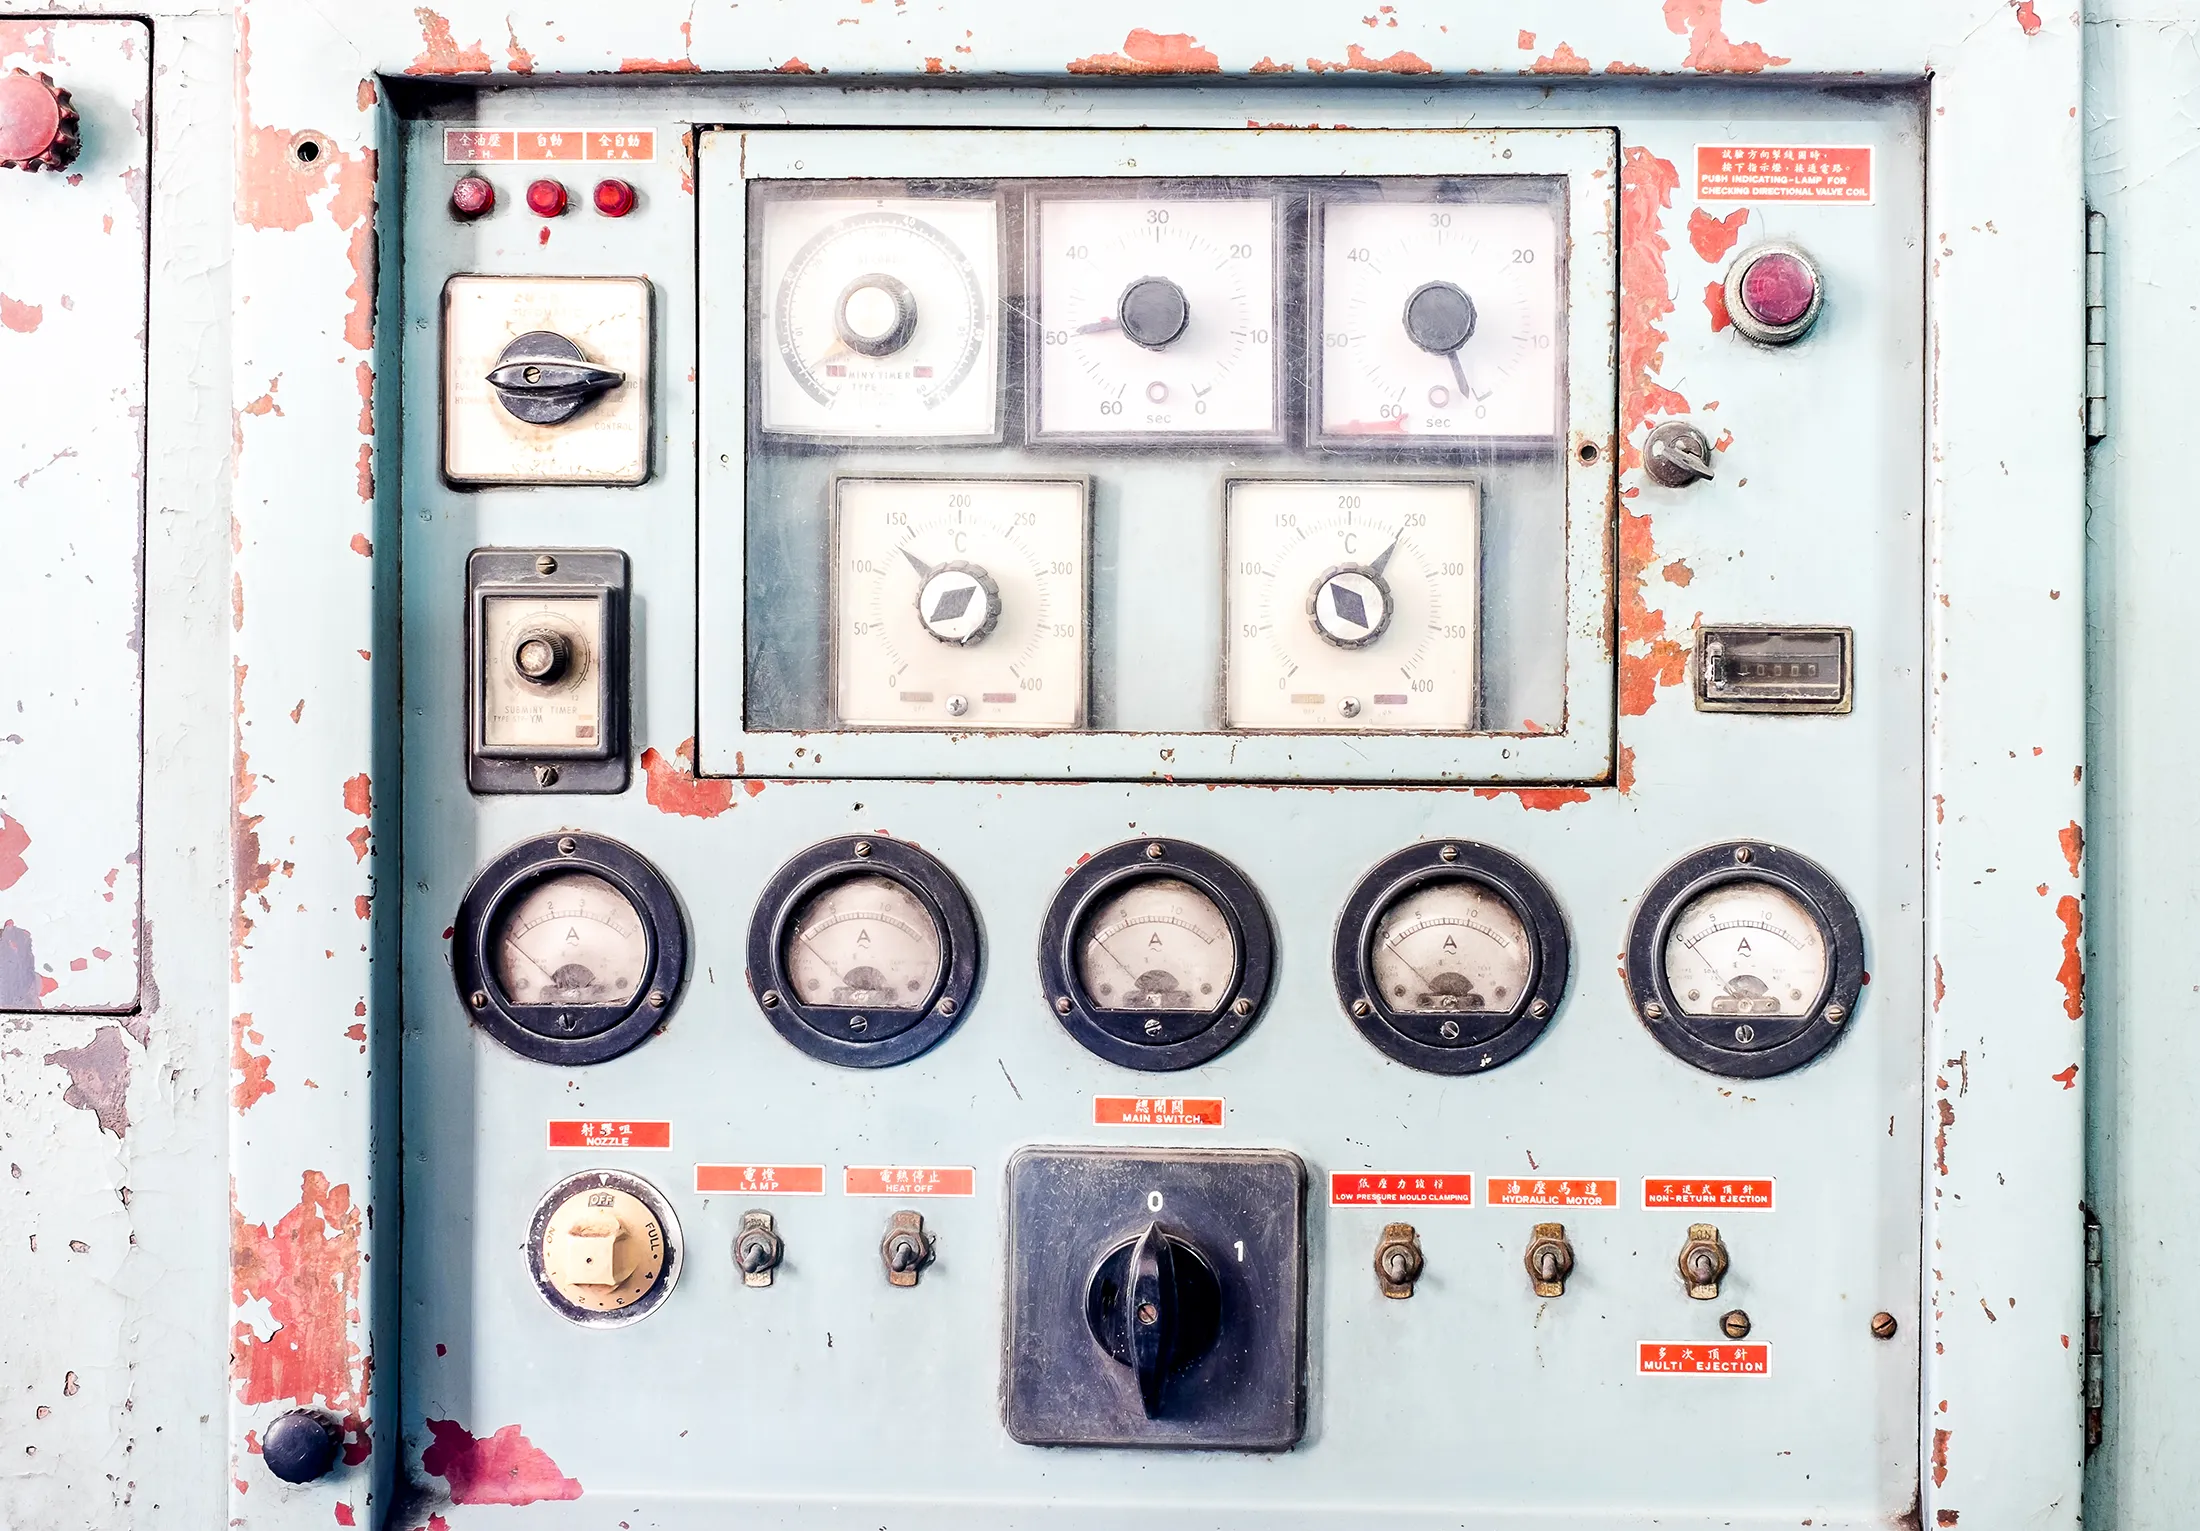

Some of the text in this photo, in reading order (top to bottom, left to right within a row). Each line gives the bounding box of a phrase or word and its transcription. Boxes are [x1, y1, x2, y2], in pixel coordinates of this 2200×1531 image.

[536, 133, 563, 147] 自動
[598, 133, 641, 147] 全自動
[545, 149, 556, 158] A.
[1701, 174, 1847, 185] PUSH INDICATING-LAMP FOR
[1701, 186, 1868, 197] CHECKING DIRECTIONAL VALVE COIL
[1146, 209, 1170, 225] 30
[1429, 213, 1452, 228] 30
[1065, 245, 1089, 260] 40
[1229, 244, 1252, 259] 20
[1347, 248, 1370, 263] 40
[1511, 249, 1535, 264] 20
[1045, 330, 1068, 346] 50
[1250, 329, 1269, 344] 10
[1325, 332, 1349, 348] 50
[1531, 335, 1550, 350] 10
[1099, 400, 1123, 416] 60
[1195, 400, 1206, 416] 0
[1379, 404, 1403, 419] 60
[1475, 405, 1487, 420] 0
[1146, 413, 1172, 424] sec
[1426, 416, 1452, 428] sec
[948, 494, 972, 508] 200
[1337, 495, 1362, 509] 200
[886, 512, 908, 526] 150
[1013, 512, 1036, 527] 250
[1274, 513, 1297, 528] 150
[1403, 513, 1427, 528] 250
[851, 559, 873, 574] 100
[1050, 561, 1074, 576] 300
[1239, 561, 1262, 576] 100
[1440, 562, 1464, 577] 300
[853, 622, 869, 636] 50
[1052, 623, 1076, 638] 350
[1242, 624, 1258, 638] 50
[1443, 624, 1467, 640] 350
[888, 674, 897, 689] 0
[1019, 677, 1044, 692] 400
[1278, 676, 1287, 691] 0
[1410, 679, 1435, 694] 400
[550, 705, 578, 715] TIMER
[546, 900, 555, 911] 2
[879, 902, 893, 913] 10
[1170, 904, 1184, 915] 10
[1465, 907, 1479, 918] 10
[1414, 910, 1423, 920] 5
[1708, 913, 1717, 923] 5
[1760, 909, 1774, 921] 10
[565, 926, 580, 941] A
[856, 928, 872, 943] A
[1148, 931, 1163, 948] A
[1676, 933, 1685, 943] 0
[1442, 934, 1458, 950] A
[1736, 937, 1753, 952] A
[1122, 1113, 1201, 1124] MAIN SWITCH
[586, 1137, 630, 1147] NOZZLE
[742, 1167, 776, 1182] 電燈
[879, 1169, 941, 1184] 電熱停止
[739, 1181, 780, 1191] LAMP
[885, 1184, 934, 1193] HEAT OFF
[589, 1194, 614, 1206] OFF
[1146, 1190, 1163, 1212] 0
[1335, 1193, 1469, 1201] LOW PRESSURE MOULD CLAMPING
[1501, 1194, 1603, 1205] HYDRAULIC MOTOR
[1648, 1194, 1769, 1204] NON-RETURN EJECTION
[645, 1221, 661, 1252] FULL
[1232, 1240, 1245, 1263] 1
[644, 1271, 655, 1281] 4
[616, 1297, 626, 1306] 3
[1658, 1346, 1749, 1362] 多次頂針
[1643, 1360, 1764, 1373] MULTI EJECTION
